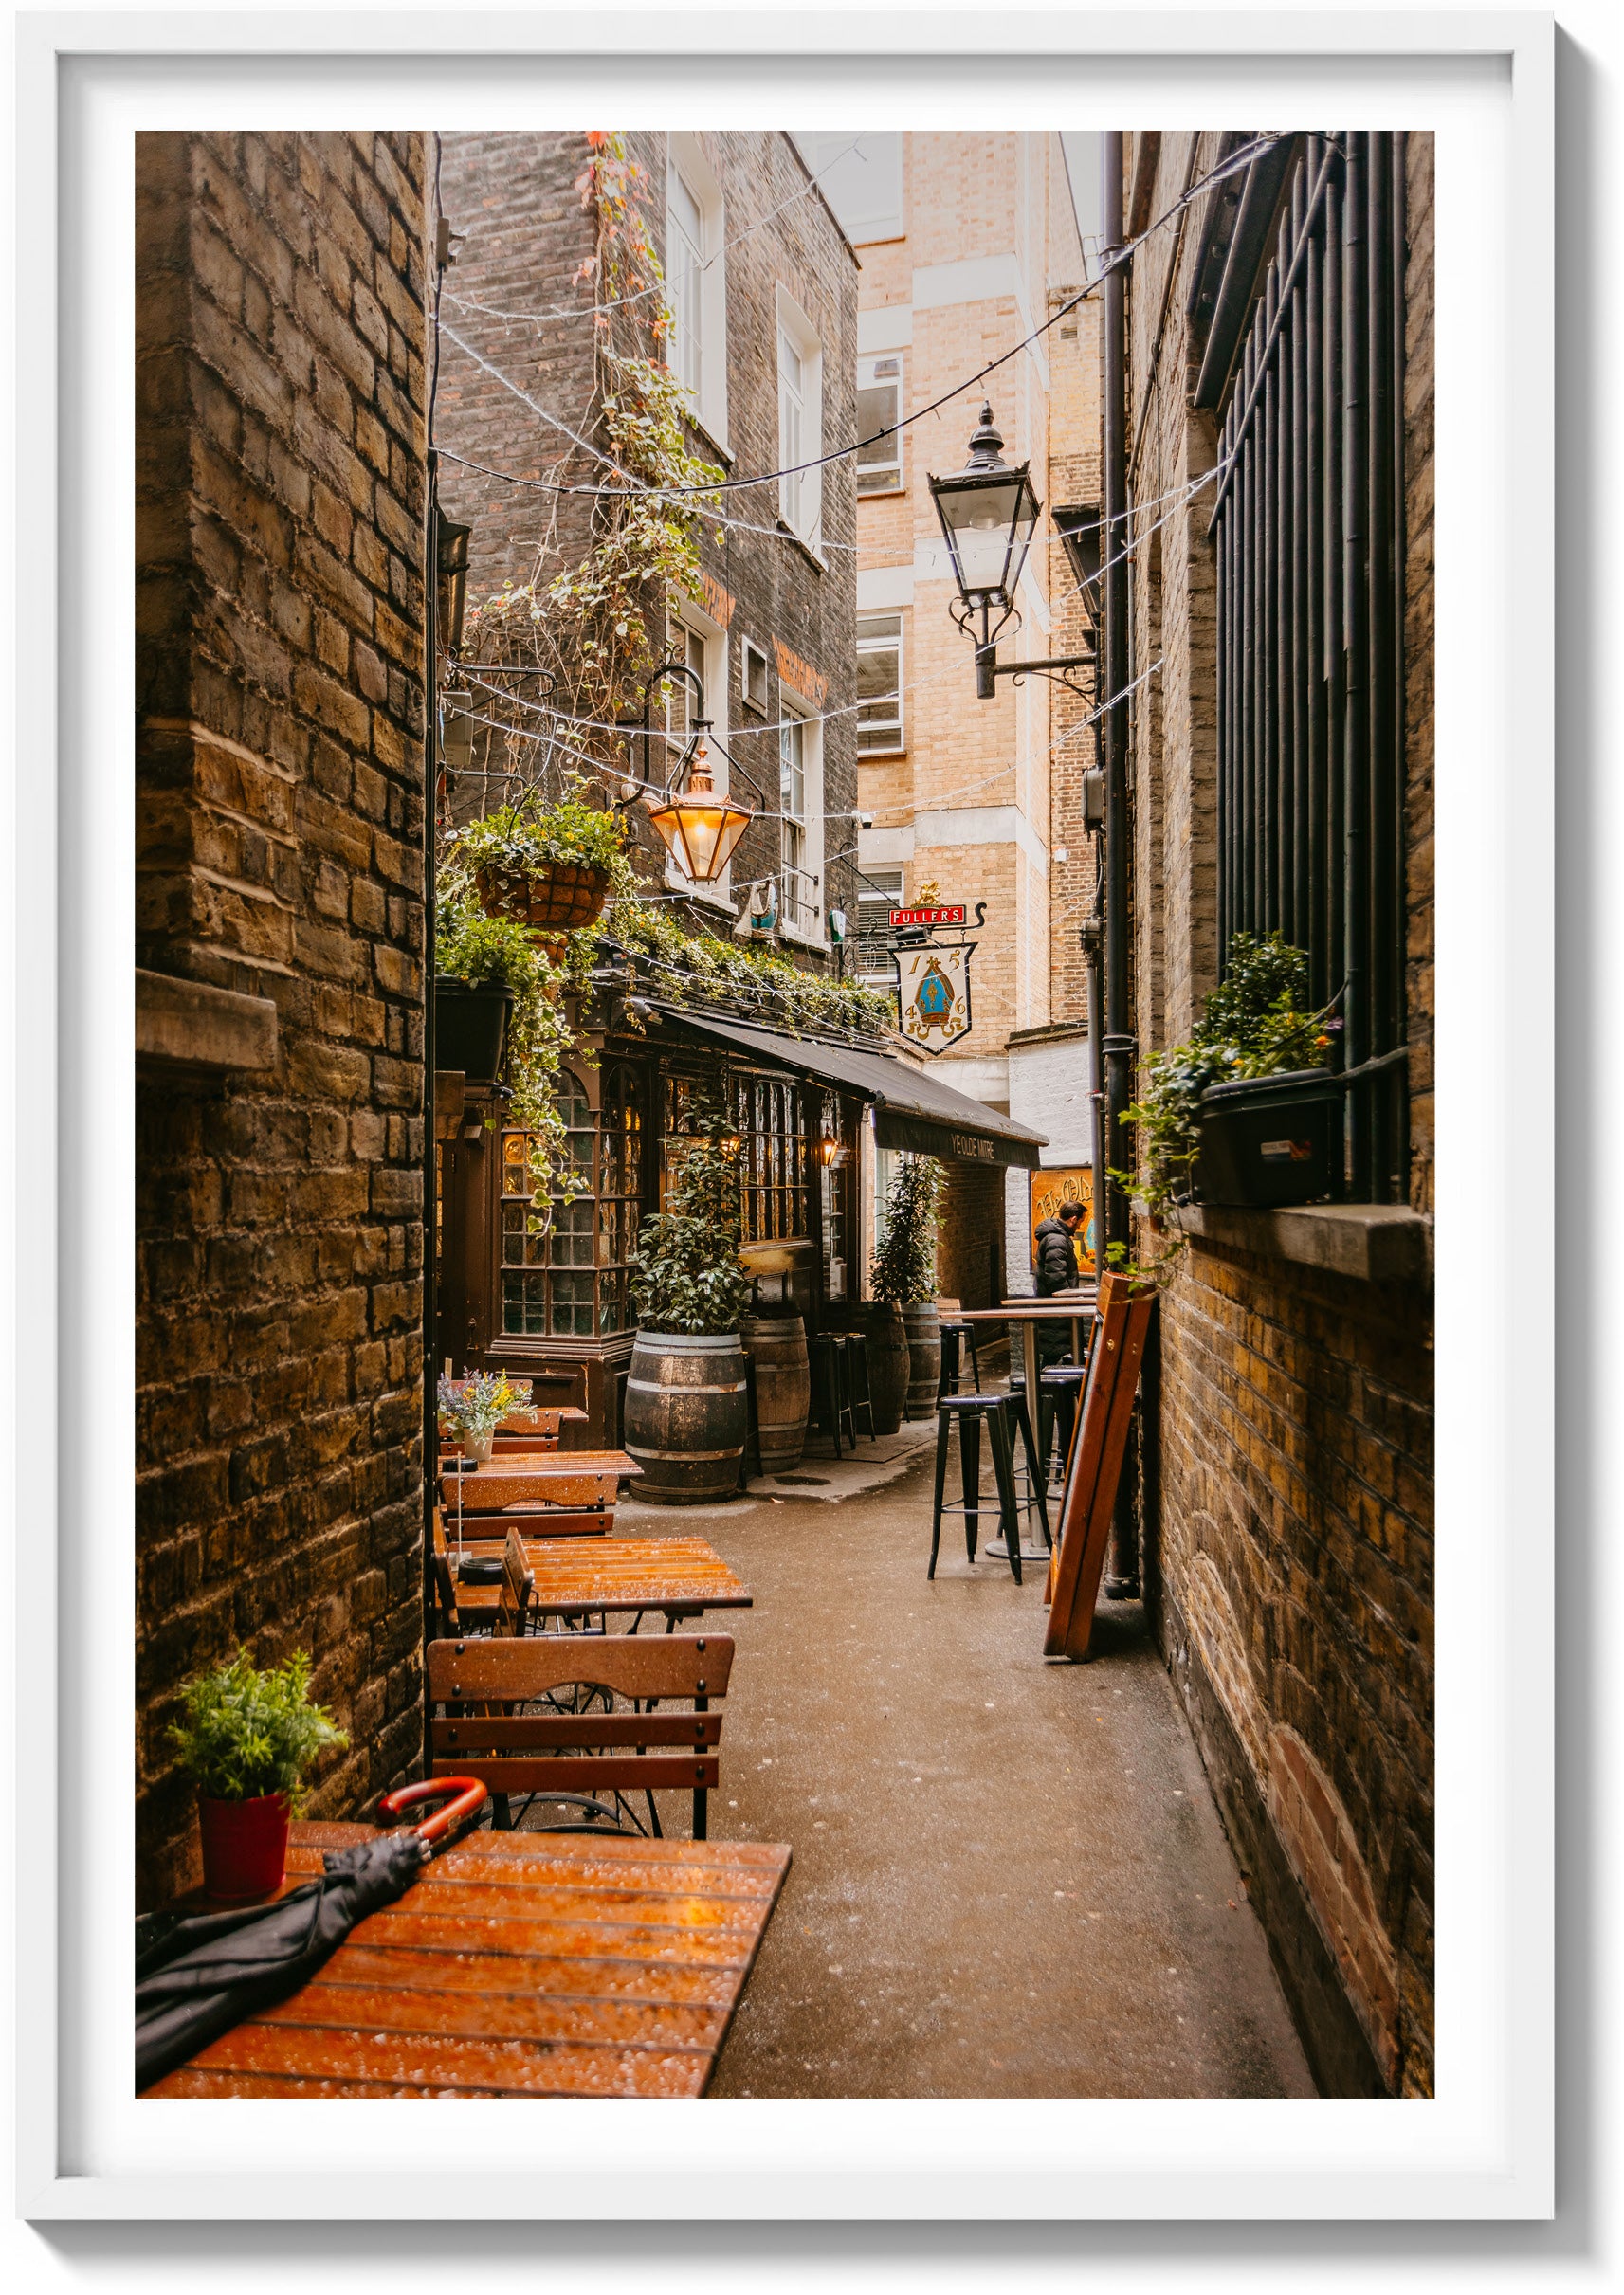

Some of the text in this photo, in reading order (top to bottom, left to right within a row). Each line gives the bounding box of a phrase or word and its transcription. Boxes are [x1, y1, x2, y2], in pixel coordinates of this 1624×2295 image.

[907, 949, 961, 975] 1 5
[905, 996, 966, 1020] 4 6
[951, 1133, 994, 1159] YE OLDE MITRE
[1062, 1175, 1094, 1202] Old
